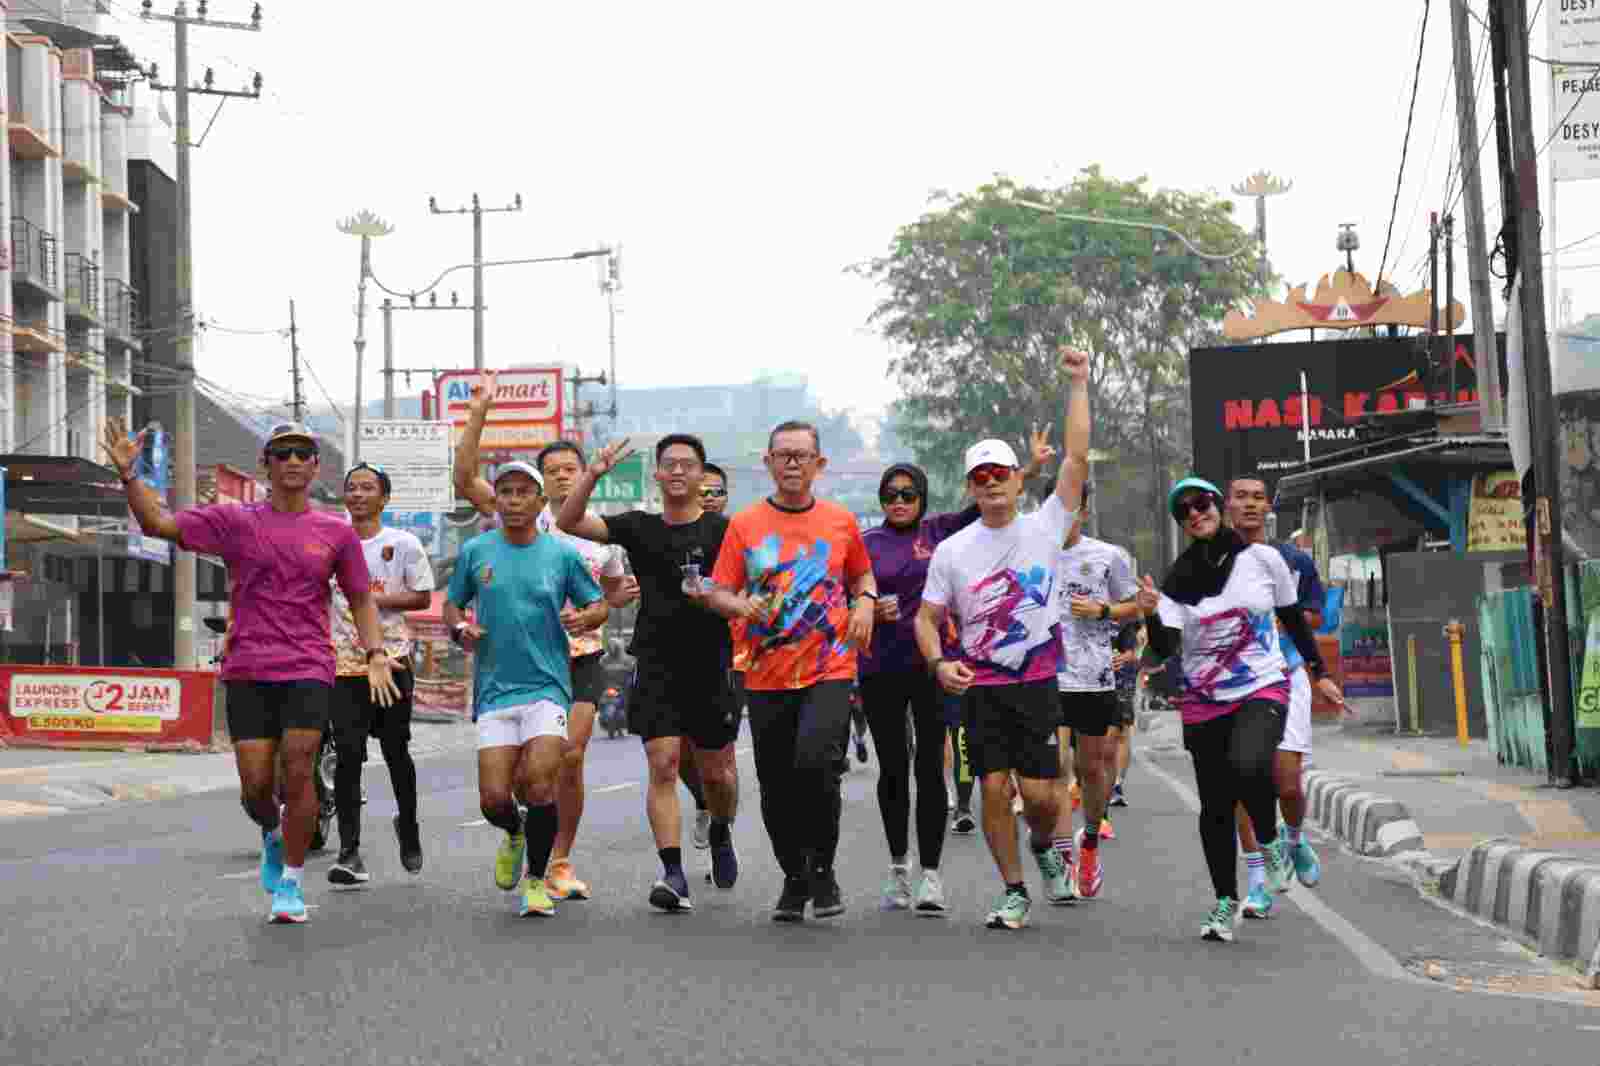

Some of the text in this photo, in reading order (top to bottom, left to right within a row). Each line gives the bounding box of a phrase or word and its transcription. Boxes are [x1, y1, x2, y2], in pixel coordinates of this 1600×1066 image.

[1224, 392, 1322, 431] NASI
[15, 683, 80, 697] LAUNDRY
[105, 682, 124, 710] 2
[127, 685, 170, 699] JAM
[15, 697, 80, 709] EXPRESS
